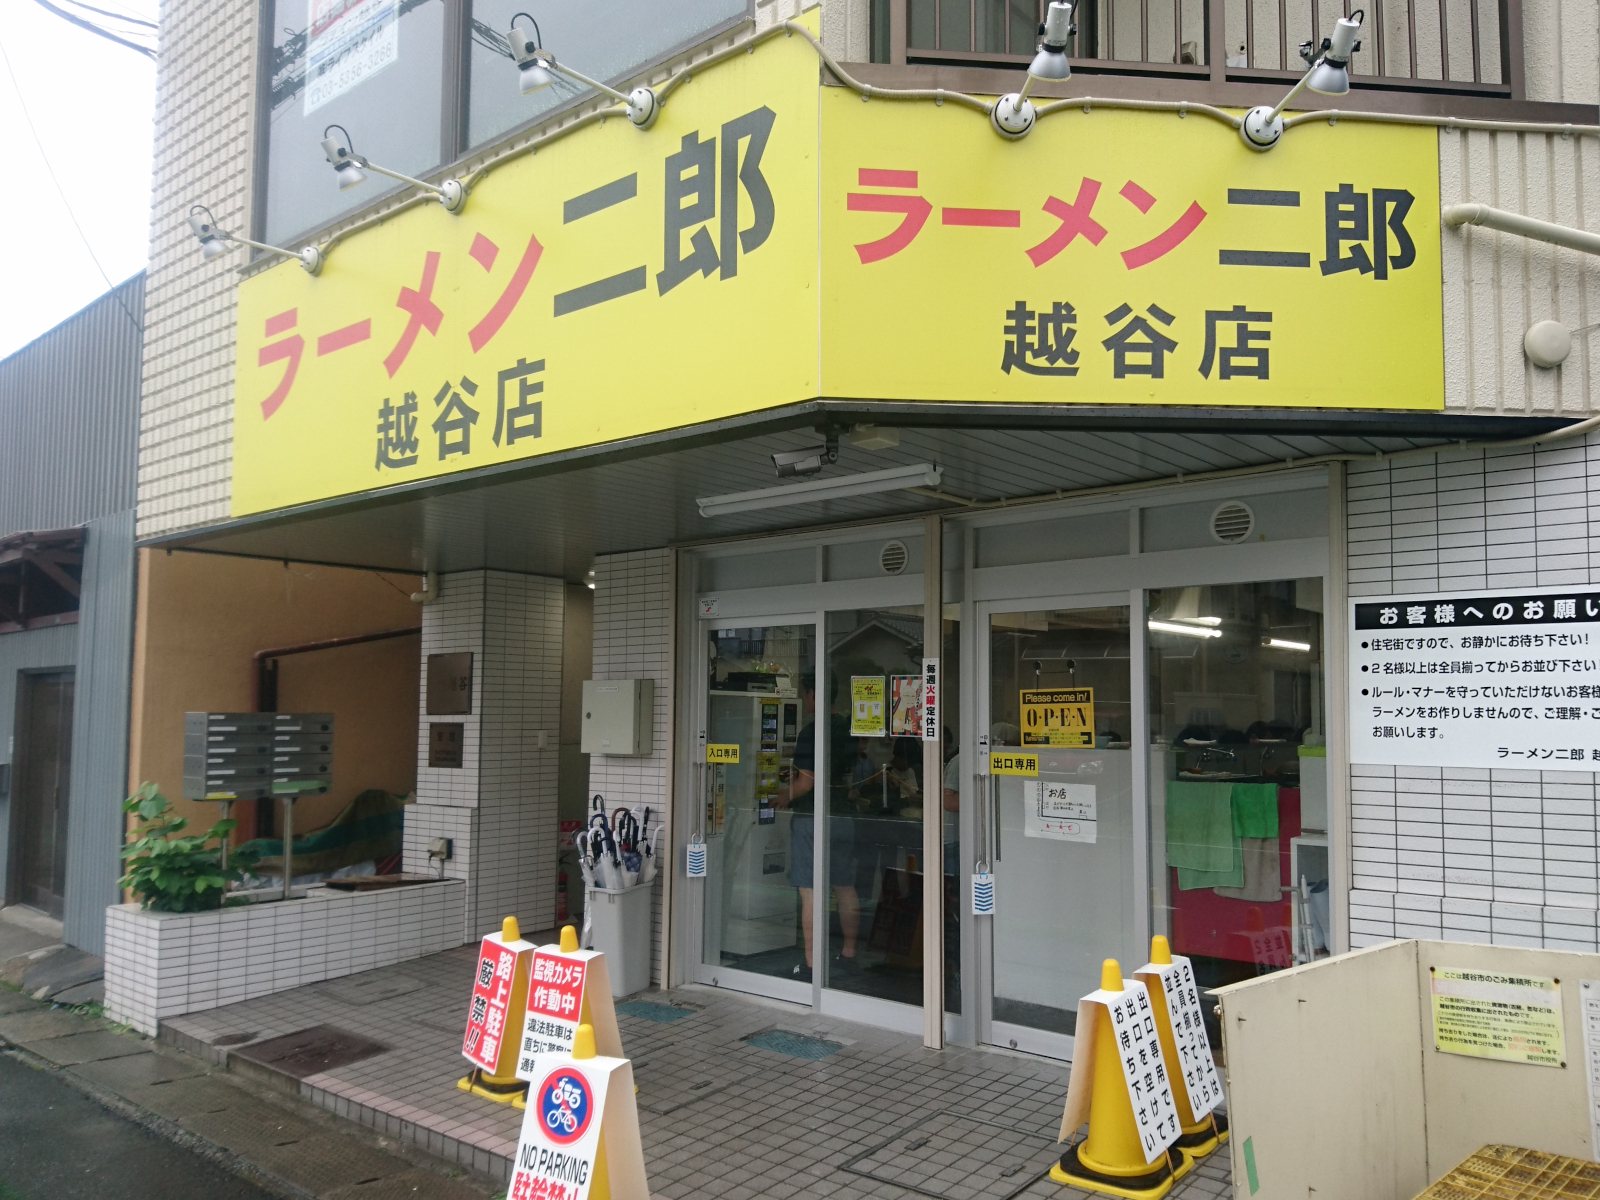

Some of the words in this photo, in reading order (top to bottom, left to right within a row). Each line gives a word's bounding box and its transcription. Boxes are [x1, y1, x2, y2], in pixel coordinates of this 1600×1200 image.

[847, 167, 1416, 281] ラーメン二郎
[258, 105, 777, 421] ラーメン二郎
[1000, 300, 1273, 381] 越谷店
[375, 357, 546, 472] 越谷店
[926, 664, 936, 738] 毎週火曜定休日
[1025, 693, 1051, 703] Please
[1053, 693, 1075, 702] come
[1372, 726, 1444, 739] お願いします。
[708, 748, 738, 759] 入口専用
[993, 757, 1036, 771] 出口専用
[1497, 747, 1585, 761] ラーメン二郎
[479, 951, 514, 1064] 路上駐車
[533, 957, 583, 988] 監視カメラ
[534, 986, 576, 1015] 作動中
[527, 1018, 573, 1041] 違法駐車は
[1137, 991, 1175, 1133] 出口専用です
[1183, 965, 1219, 1097] 2名様以上は
[1114, 1005, 1155, 1152] お待ち下さい
[1125, 998, 1166, 1141] 出口を空けて
[519, 1143, 538, 1170] NO
[538, 1148, 589, 1186] PARKING
